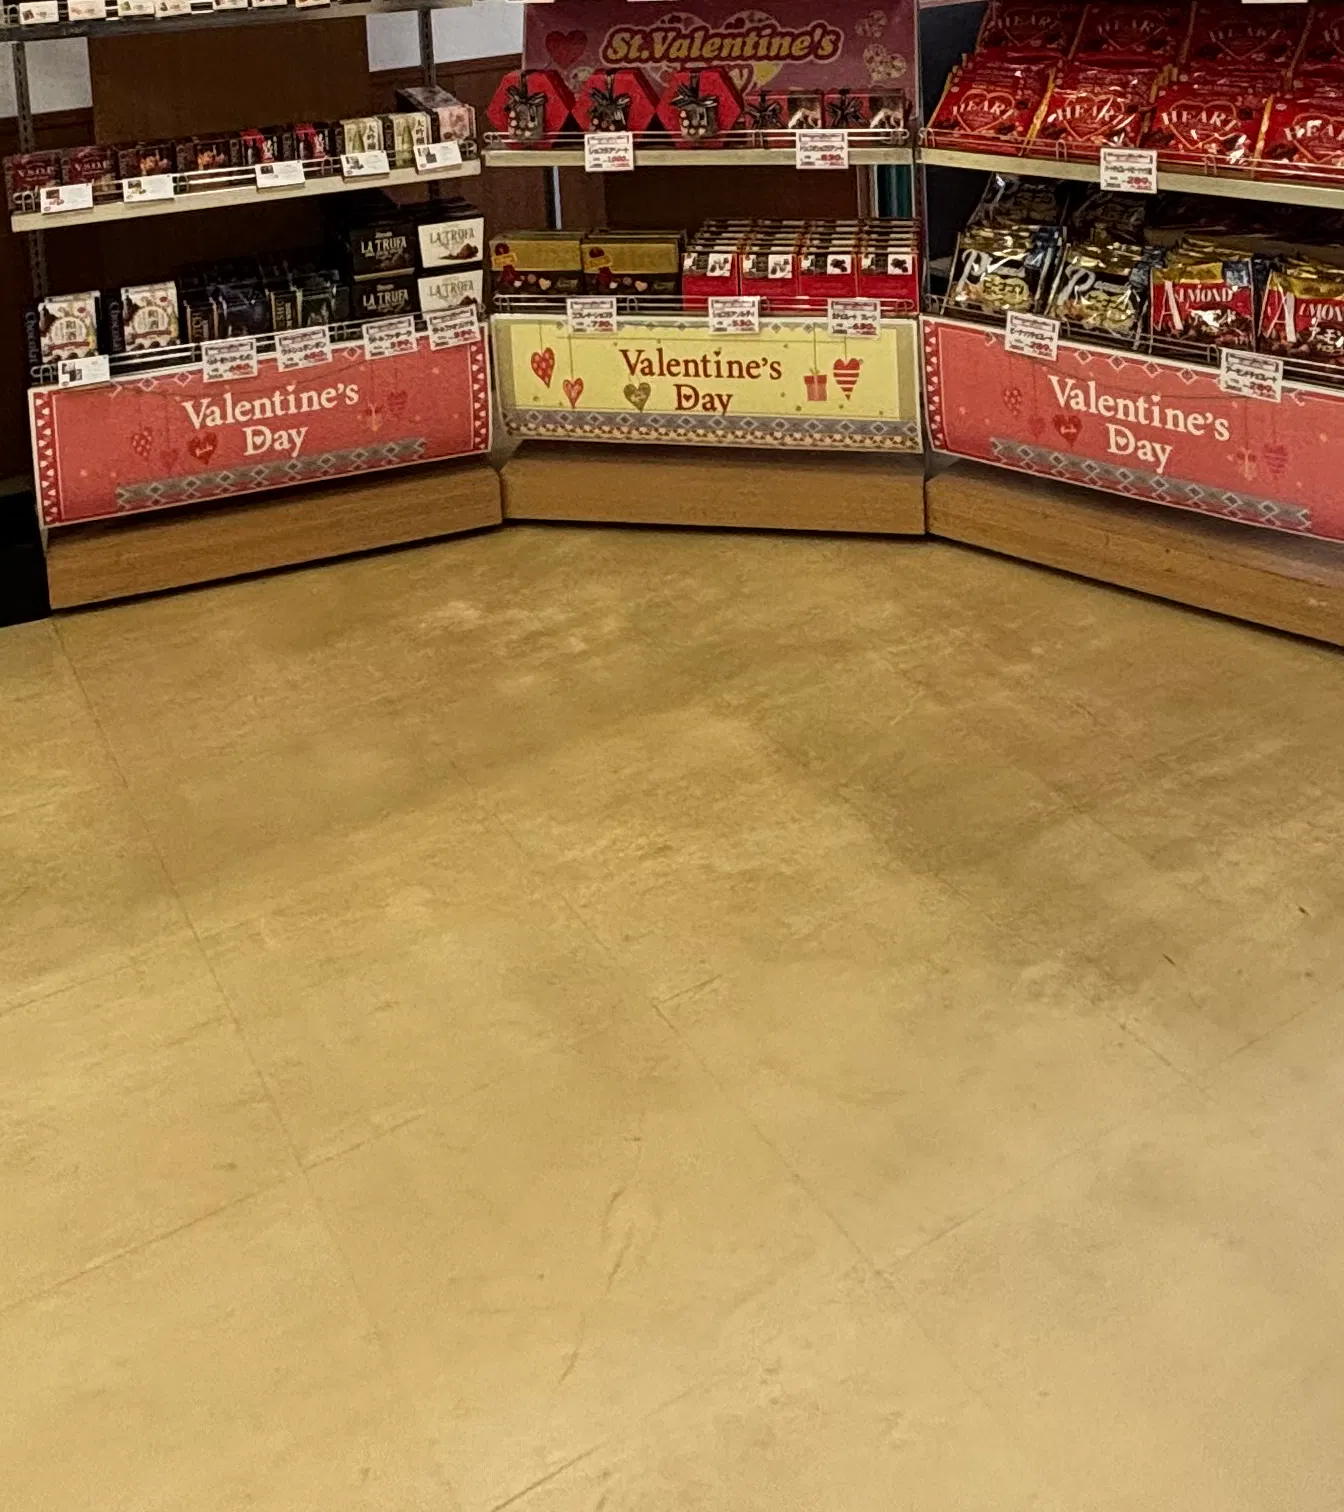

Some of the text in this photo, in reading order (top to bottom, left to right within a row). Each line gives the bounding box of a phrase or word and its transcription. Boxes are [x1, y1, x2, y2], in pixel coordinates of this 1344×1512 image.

[1161, 111, 1242, 133] HEART
[360, 235, 408, 257] LA TRUFA
[362, 288, 409, 308] LA TRUFA
[618, 347, 783, 382] Valentine's
[181, 382, 361, 431] Valentine's
[673, 383, 734, 416] Day
[1047, 374, 1231, 442] Valentine's
[243, 425, 310, 459] Day
[1105, 423, 1174, 474] Day
